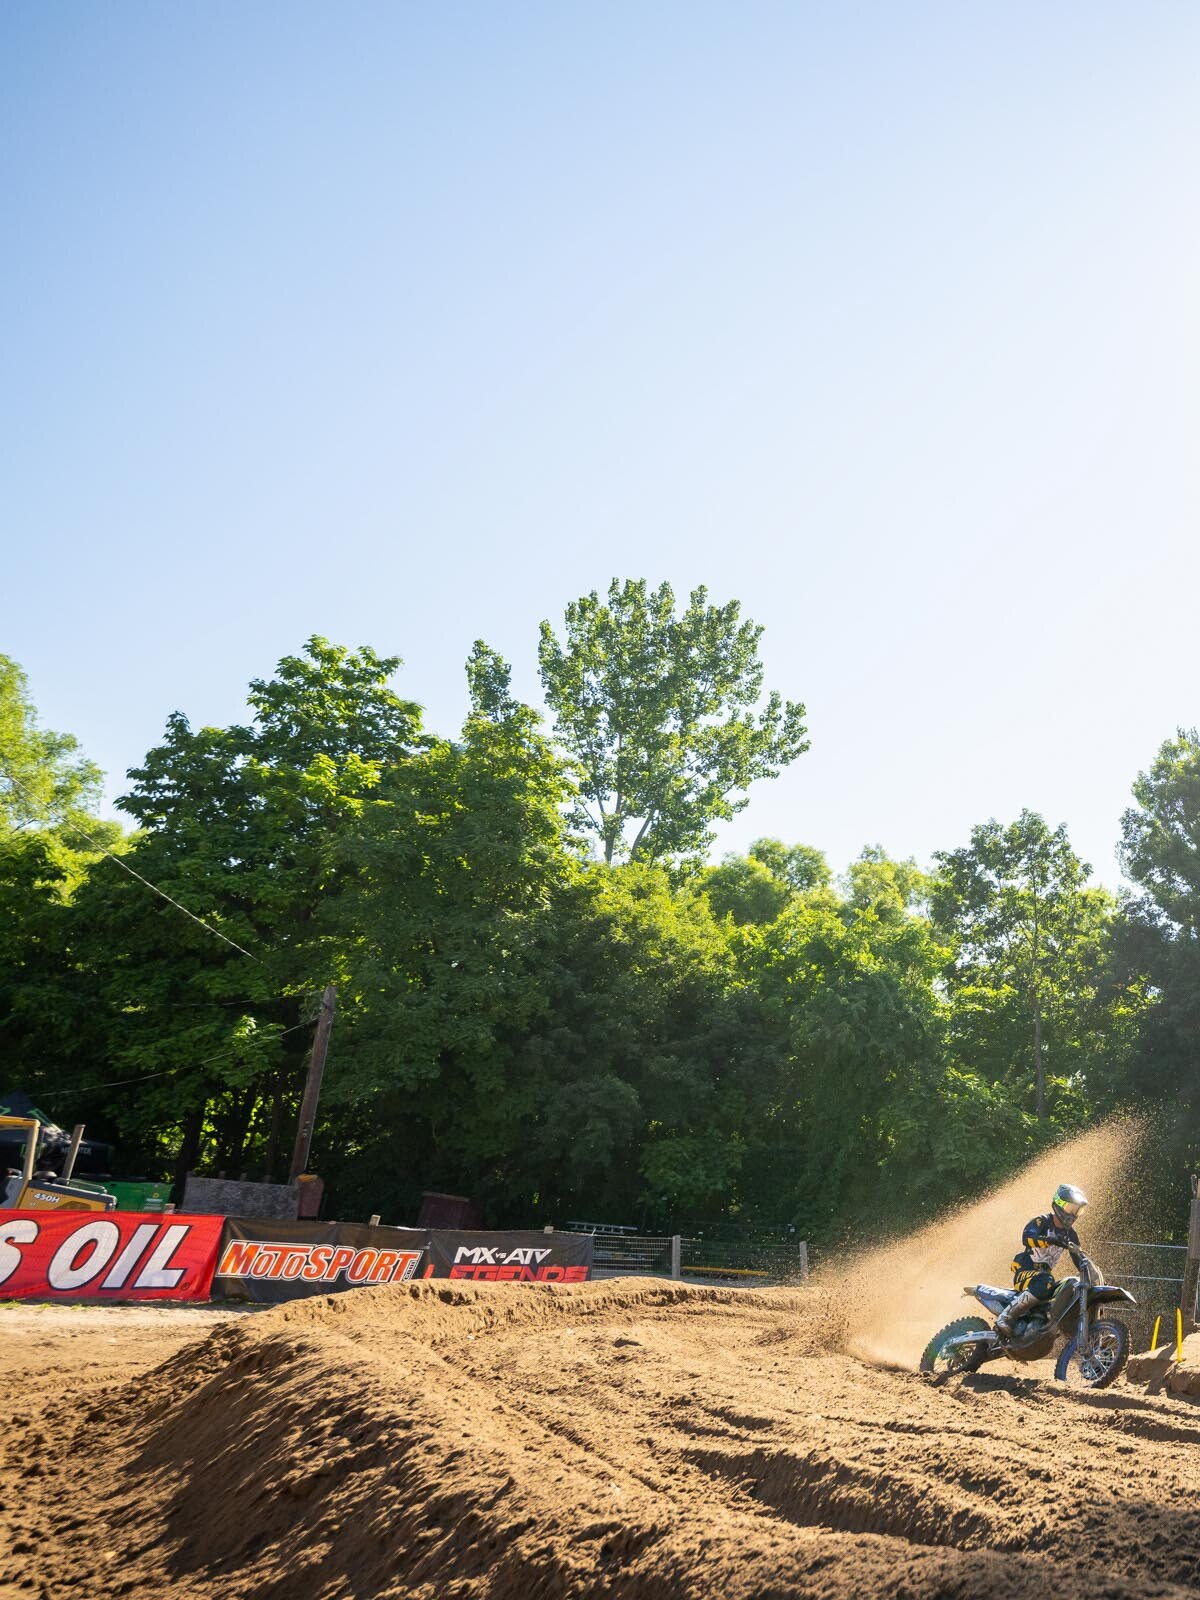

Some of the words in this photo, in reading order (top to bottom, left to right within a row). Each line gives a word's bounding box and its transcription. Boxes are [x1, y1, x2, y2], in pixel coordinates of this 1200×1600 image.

[34, 1193, 60, 1204] 450H
[48, 1219, 192, 1291] OIL
[453, 1246, 499, 1265] MX
[502, 1248, 552, 1265] ATV
